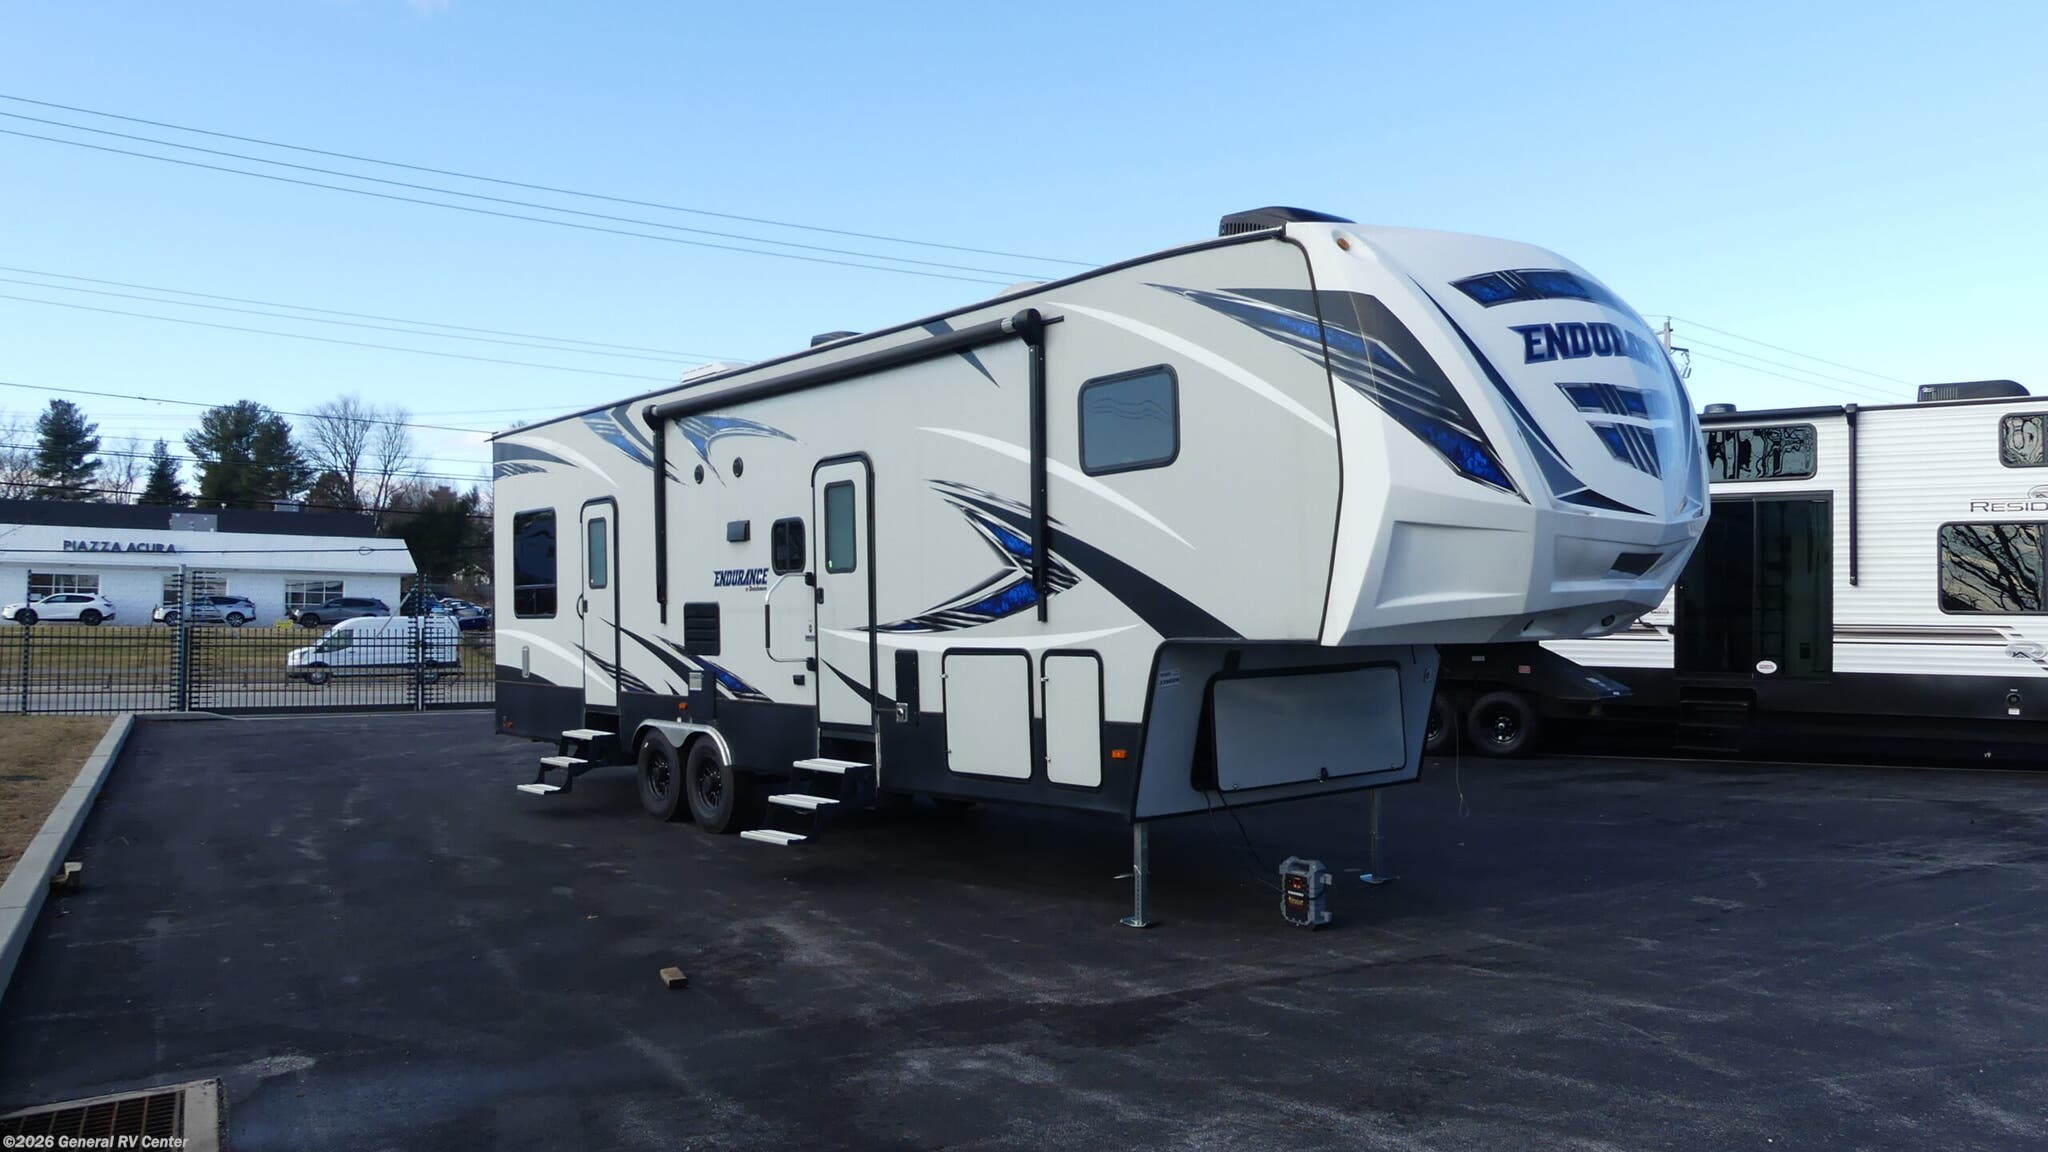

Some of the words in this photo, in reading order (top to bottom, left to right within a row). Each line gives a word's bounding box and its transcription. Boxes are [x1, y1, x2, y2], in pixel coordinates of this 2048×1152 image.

[1507, 322, 1660, 371] ENDURA
[63, 540, 122, 553] PIAZZA
[126, 542, 177, 553] ACURA
[713, 568, 769, 587] ENDURANCE
